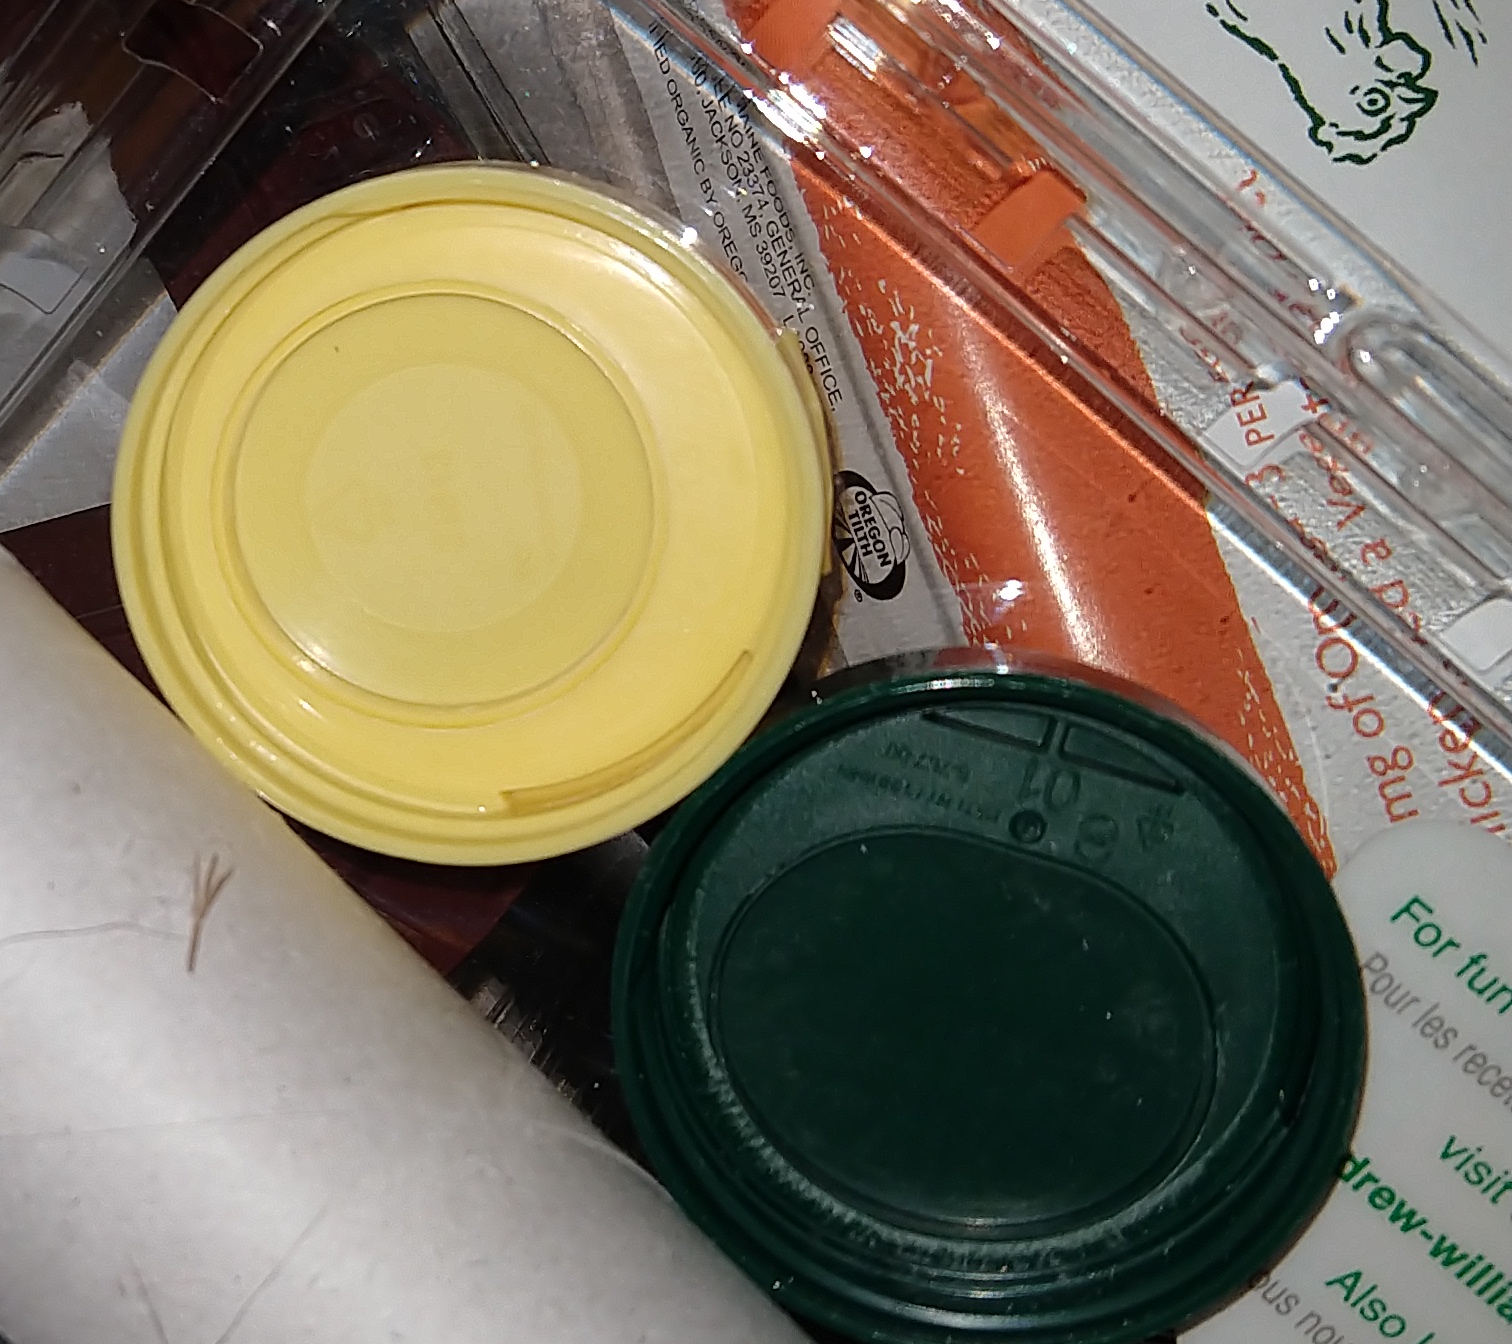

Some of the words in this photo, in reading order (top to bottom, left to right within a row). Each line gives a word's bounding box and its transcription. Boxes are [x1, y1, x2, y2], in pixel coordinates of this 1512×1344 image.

[666, 79, 707, 174] ORGANIC
[699, 176, 719, 204] BY
[701, 98, 742, 204] JACKSON,
[742, 205, 762, 238] MS
[756, 244, 786, 298] 39207
[760, 166, 794, 250] FOODS,
[795, 252, 816, 297] INC.
[724, 114, 744, 149] NO
[736, 150, 770, 220] 23374,
[766, 221, 810, 324] GENERAL
[804, 325, 843, 414] OFFICE,
[1230, 381, 1276, 447] PER
[847, 509, 874, 558] TILTH
[853, 490, 892, 568] OREGON
[1326, 692, 1386, 738] of
[1365, 744, 1420, 824] mg
[1390, 894, 1462, 958] For
[1455, 952, 1512, 1015] fun
[1363, 951, 1422, 1016] Pour
[1412, 1001, 1459, 1051] les
[1439, 1134, 1512, 1205] visit
[1324, 1268, 1407, 1338] Also
